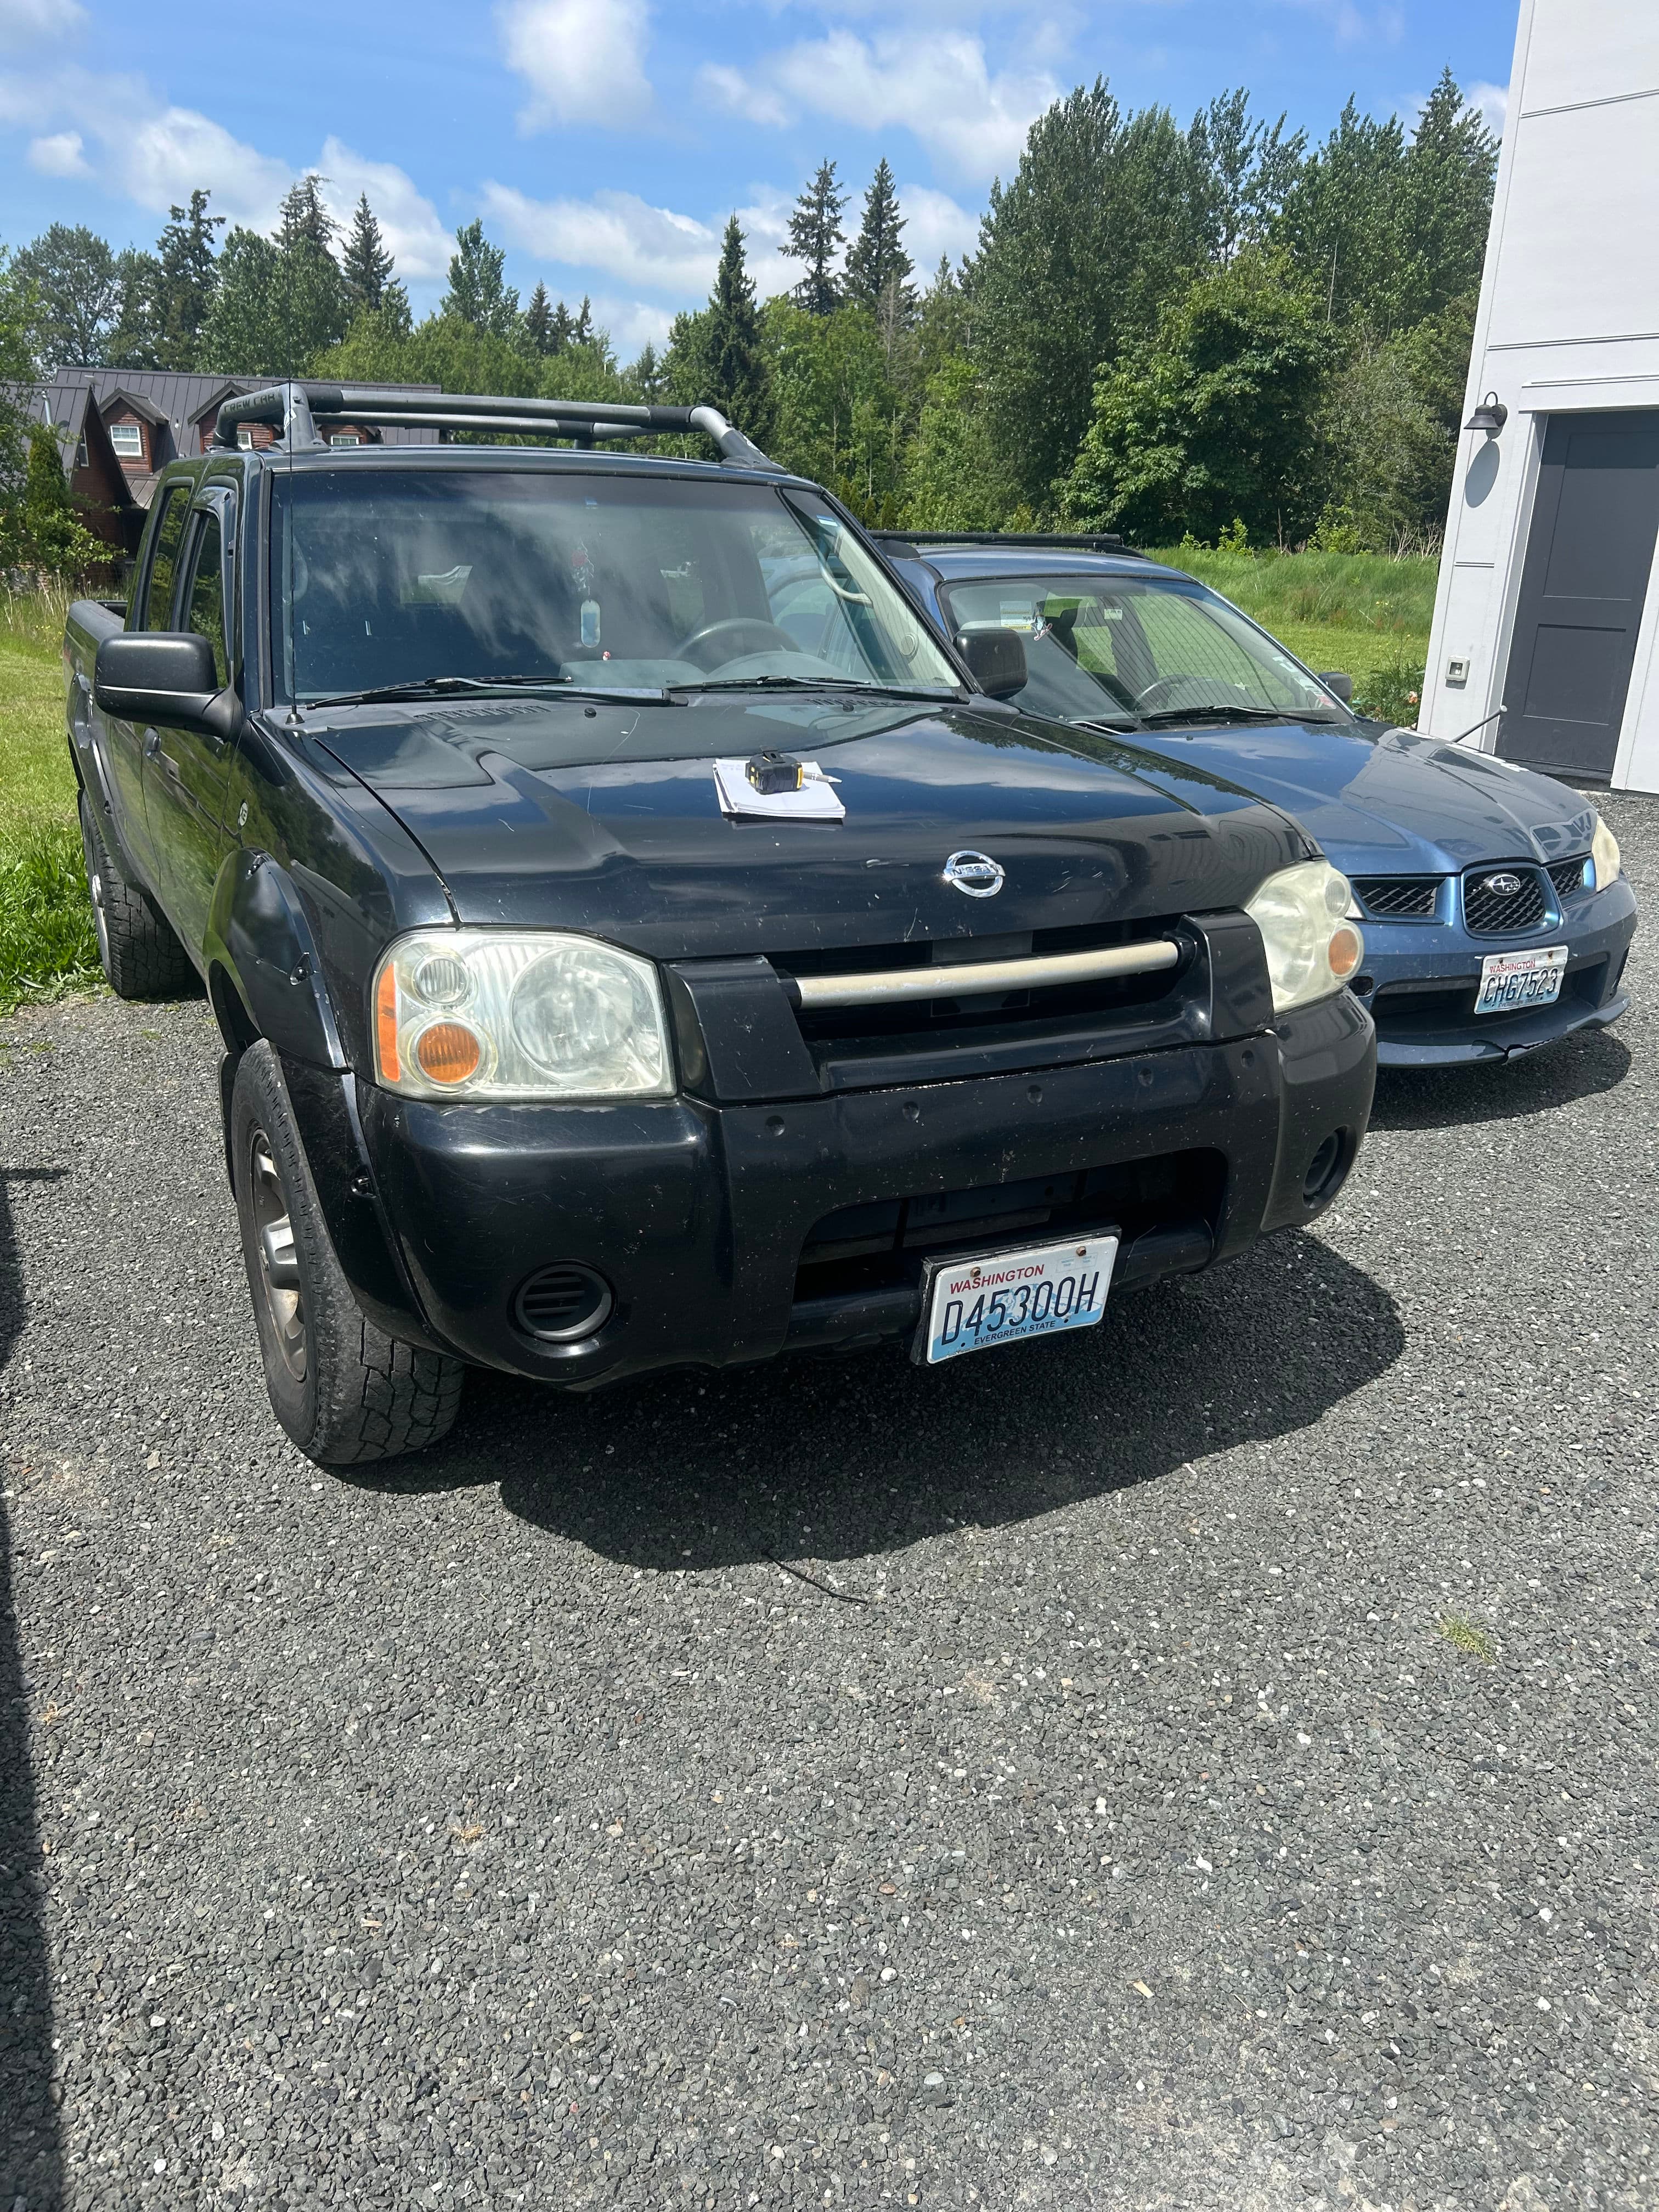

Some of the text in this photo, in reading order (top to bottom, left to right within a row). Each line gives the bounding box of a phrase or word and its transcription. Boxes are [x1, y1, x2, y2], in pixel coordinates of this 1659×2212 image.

[224, 393, 275, 413] CREW CAB
[1489, 960, 1536, 974] WASHINGTON
[1483, 967, 1559, 1003] CHG7523
[950, 1264, 1045, 1294] WASHINGTON
[941, 1271, 1099, 1346] D45300H
[974, 1320, 1056, 1345] EVERGREEN STATE
